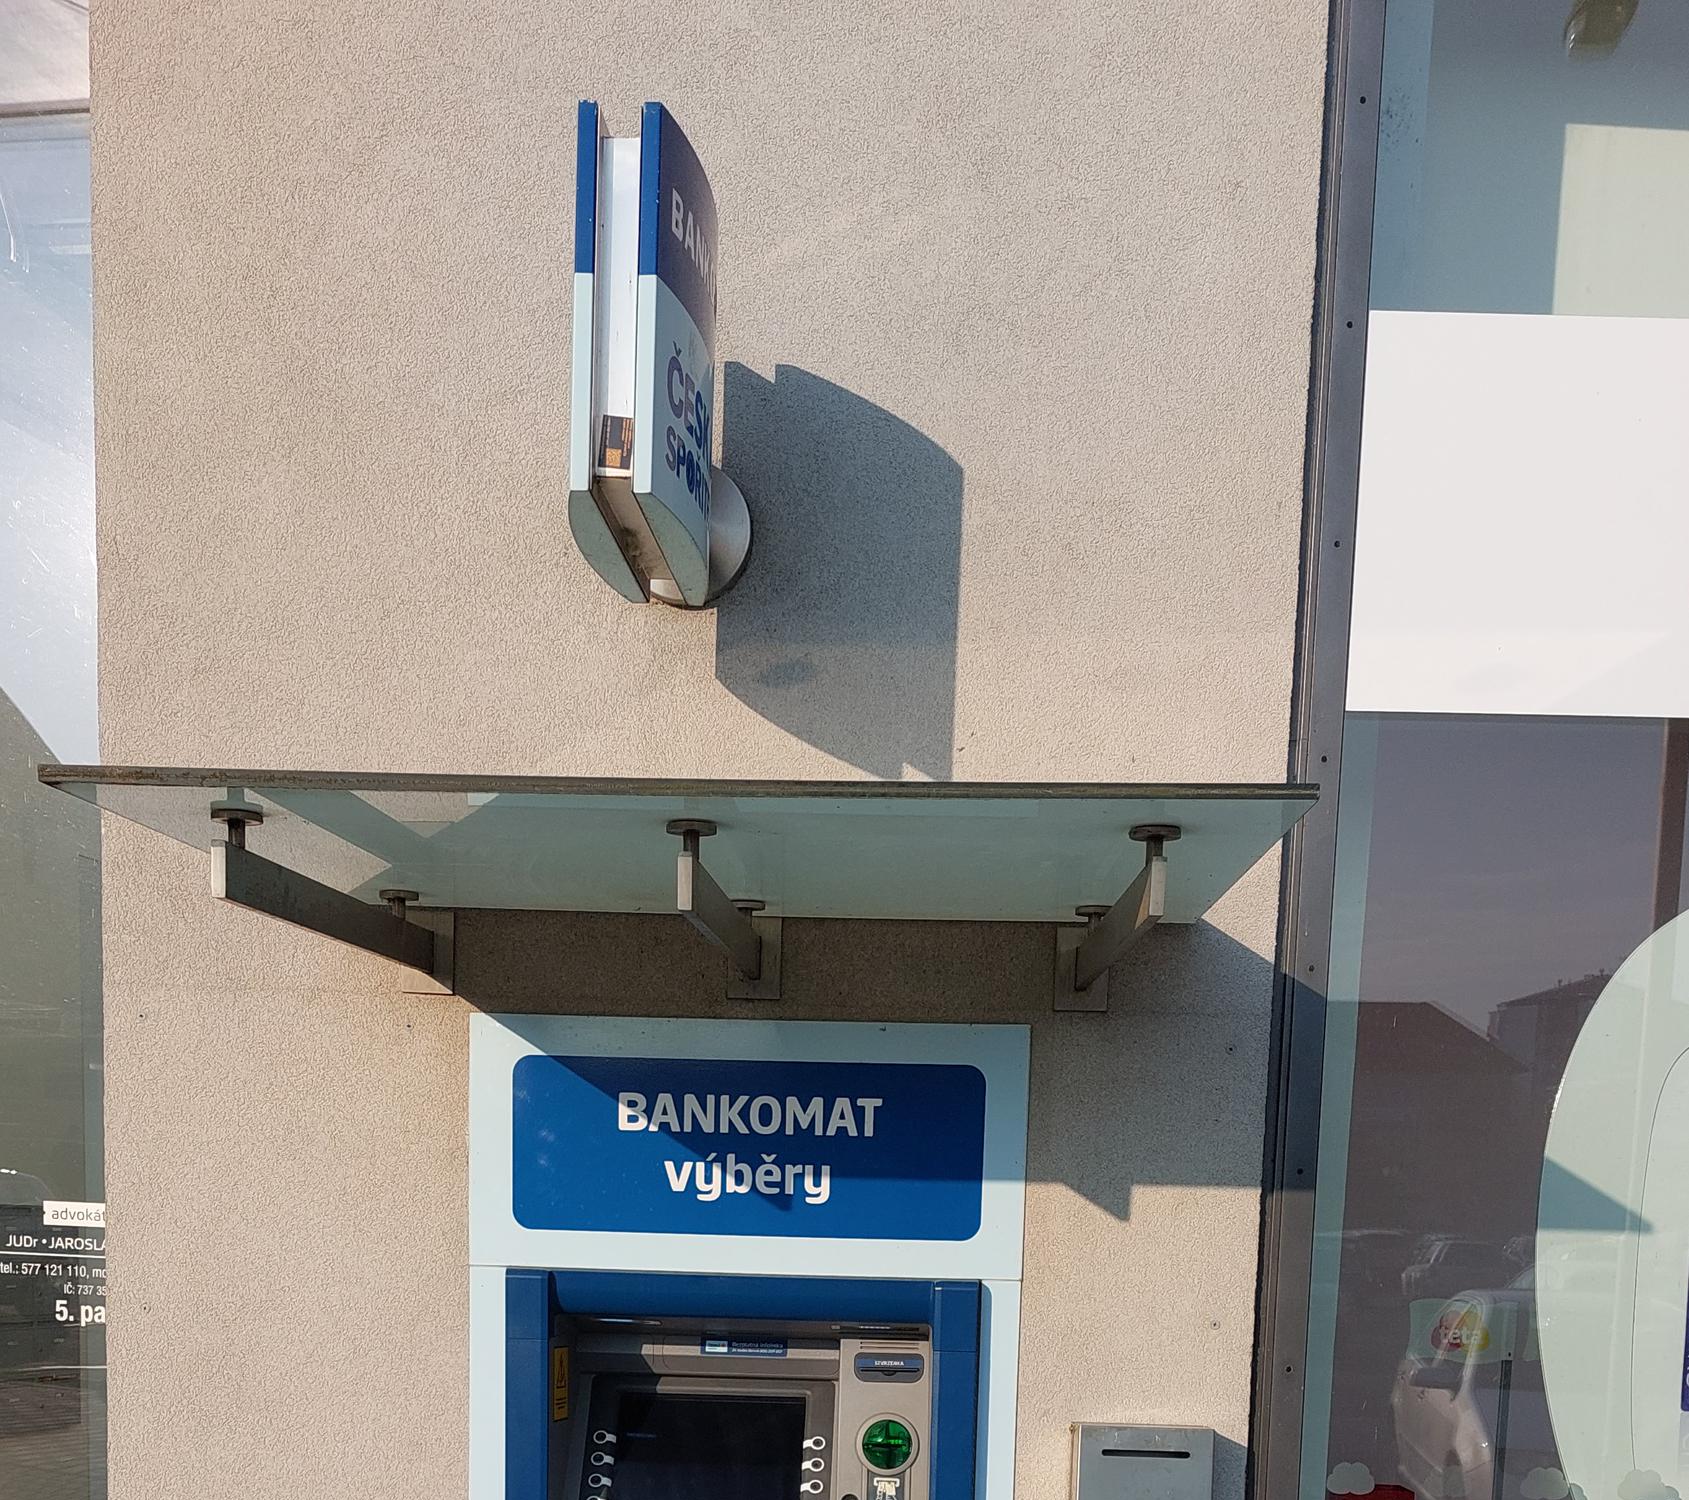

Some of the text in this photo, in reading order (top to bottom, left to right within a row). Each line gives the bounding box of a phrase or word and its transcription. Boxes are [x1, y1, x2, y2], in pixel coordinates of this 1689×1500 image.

[617, 1091, 883, 1138] BANKOMAT
[664, 1153, 832, 1205] výběry
[21, 1263, 42, 1275] 577
[44, 1264, 63, 1276] 121
[77, 1284, 93, 1296] 737
[55, 1300, 75, 1322] 5.
